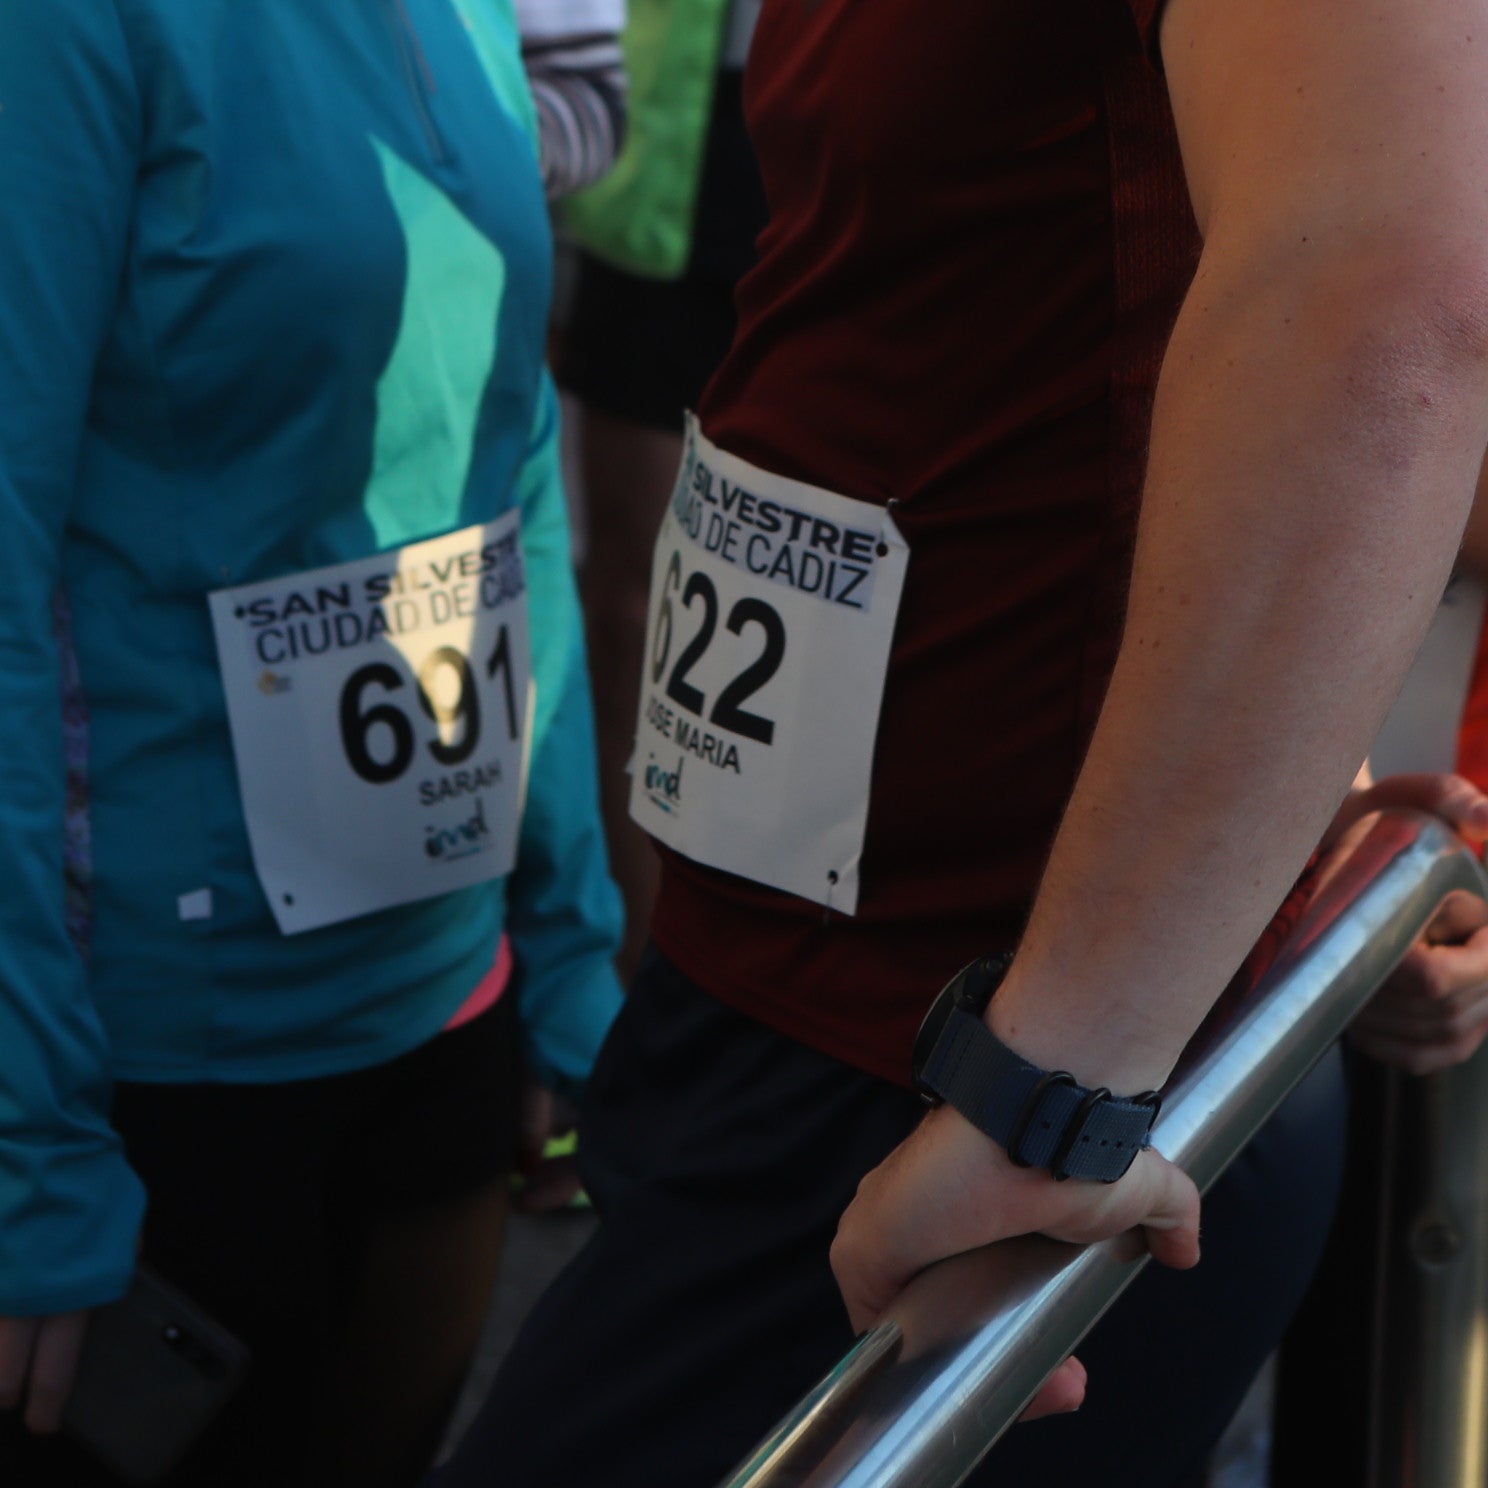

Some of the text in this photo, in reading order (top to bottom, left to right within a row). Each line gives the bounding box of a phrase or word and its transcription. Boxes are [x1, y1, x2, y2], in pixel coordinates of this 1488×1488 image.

[705, 512, 741, 562] DE
[247, 582, 351, 628] SAN
[256, 599, 422, 665] CIUDAD
[432, 587, 476, 626] DE
[650, 549, 787, 747] 622
[339, 623, 520, 786] 691
[674, 717, 742, 775] MARIA
[417, 759, 502, 807] SARAH
